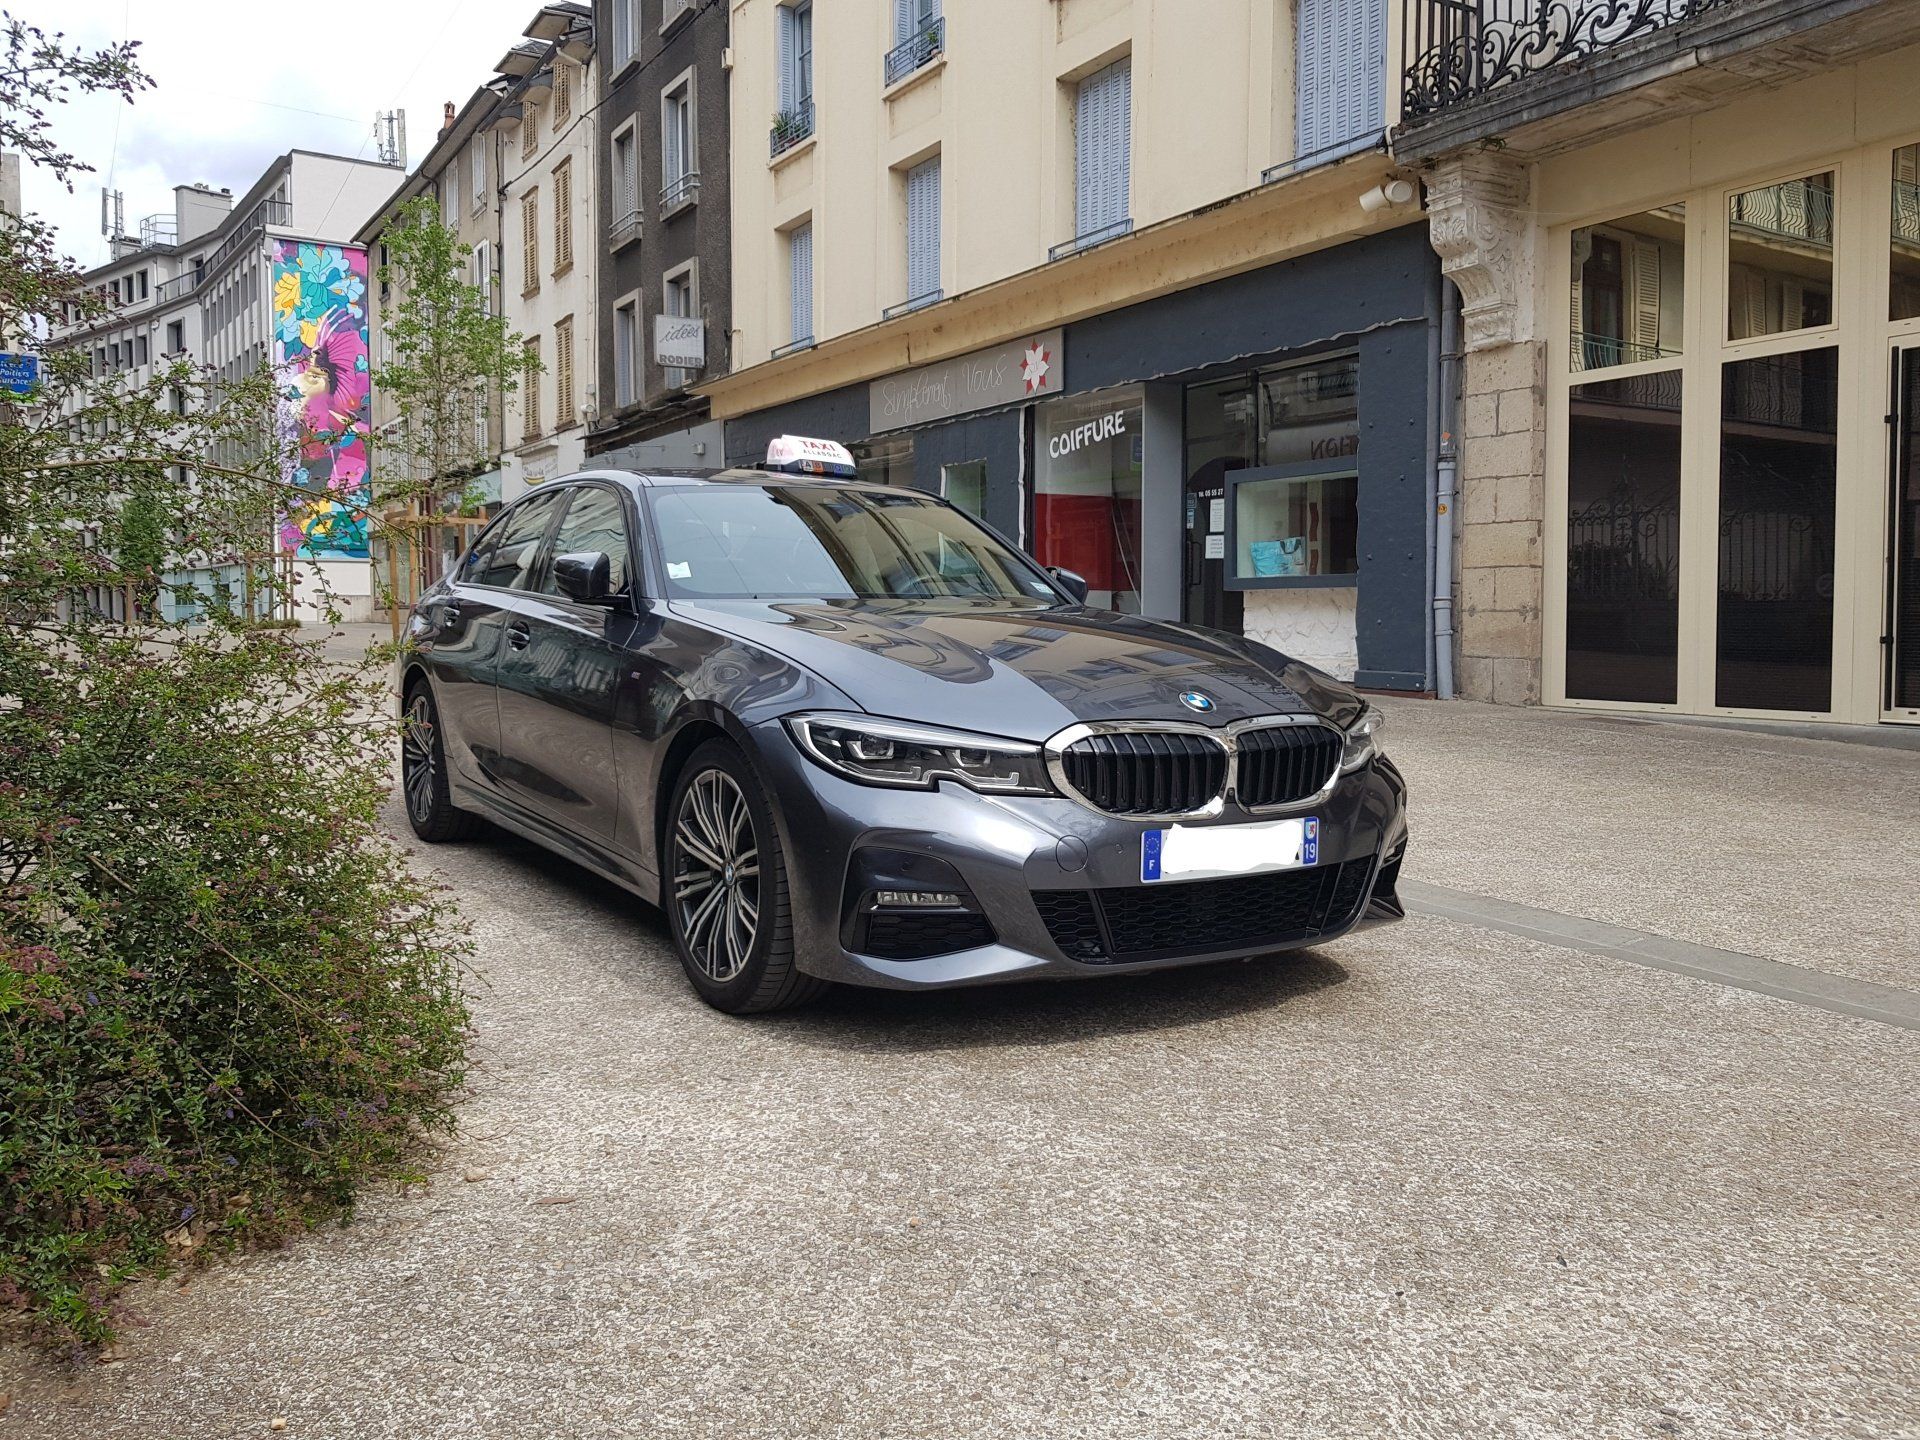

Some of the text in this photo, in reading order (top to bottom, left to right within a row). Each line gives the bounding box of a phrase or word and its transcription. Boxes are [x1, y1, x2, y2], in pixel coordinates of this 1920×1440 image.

[659, 323, 701, 342] idées
[659, 354, 703, 367] RODIER
[962, 353, 1008, 394] Vous
[1049, 410, 1126, 459] COIFFURE
[800, 440, 837, 451] TAXI
[804, 449, 842, 458] ALLASSAC
[1304, 843, 1316, 859] 19
[1149, 860, 1155, 870] F
